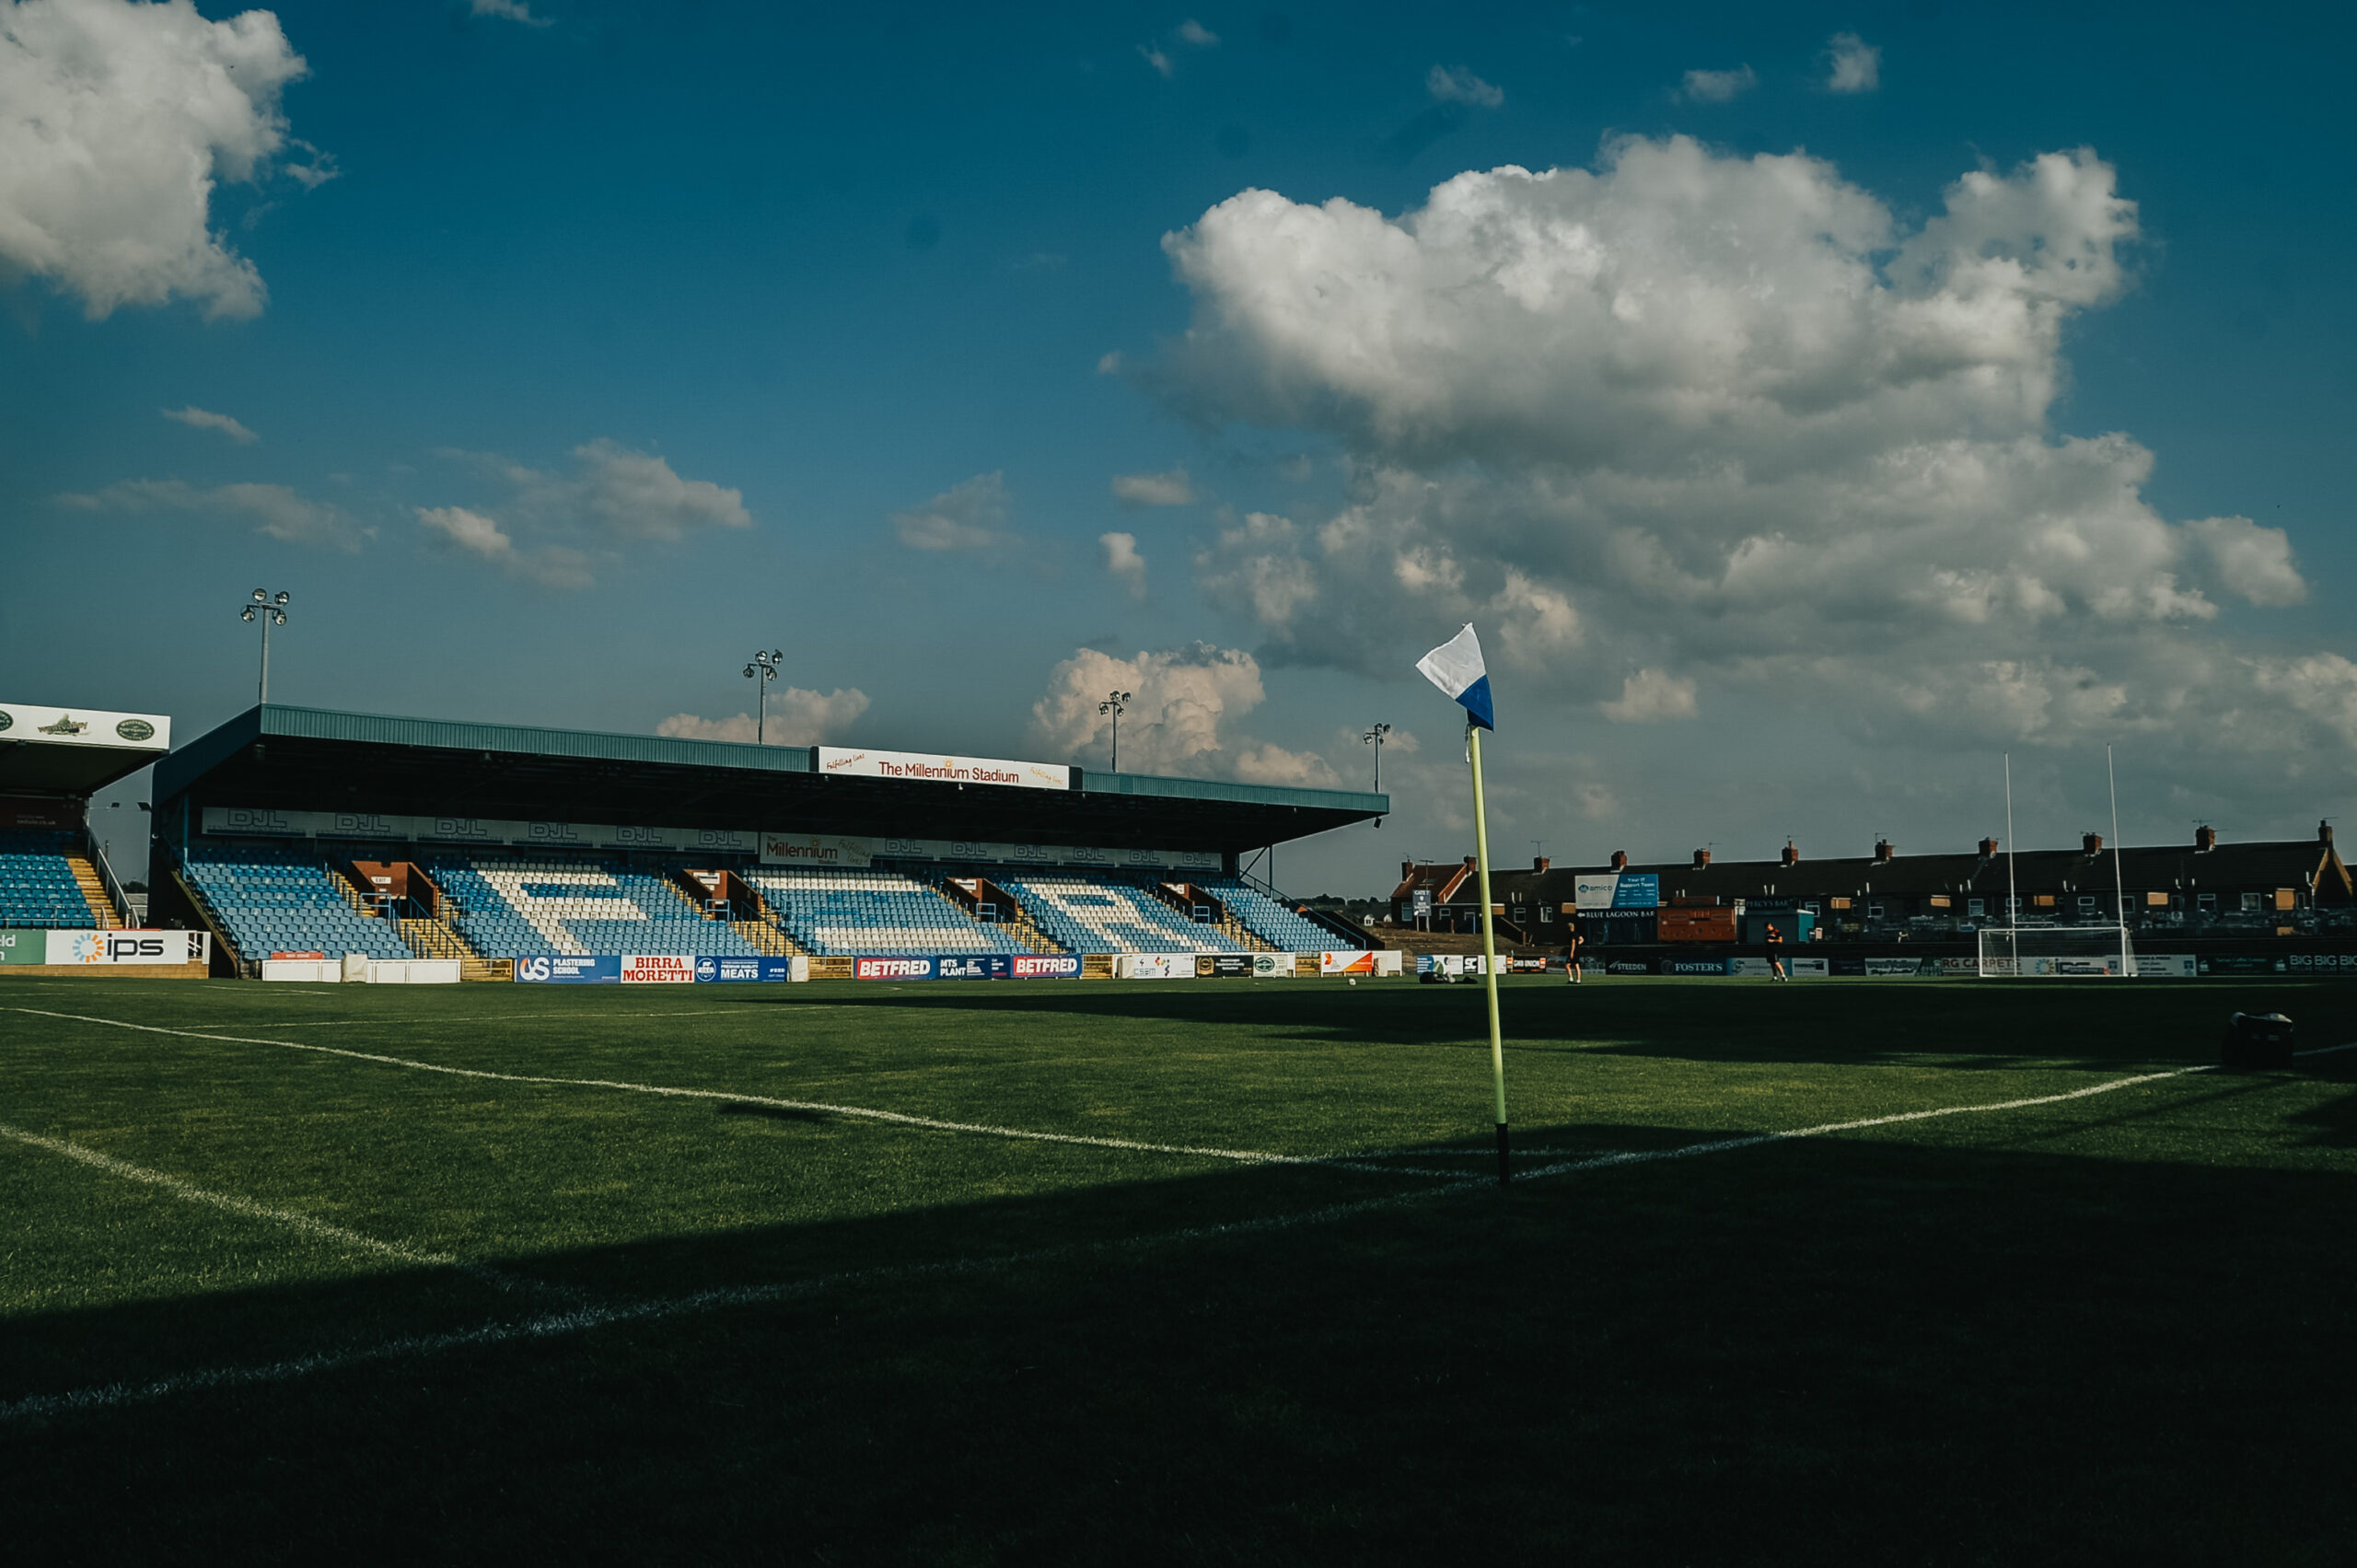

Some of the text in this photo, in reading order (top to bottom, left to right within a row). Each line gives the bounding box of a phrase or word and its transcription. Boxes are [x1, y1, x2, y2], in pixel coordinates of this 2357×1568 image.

[878, 761, 1019, 784] The Millennium Stadium
[228, 809, 287, 829] DJL
[335, 813, 390, 832] DJL
[435, 818, 487, 836] DJL
[528, 822, 577, 840] DJL
[616, 825, 662, 842] DJL
[699, 830, 741, 846] DJL
[766, 841, 838, 860] Millennium
[885, 839, 922, 854] DJL
[951, 842, 986, 856] DJL
[1014, 845, 1048, 859] DJL
[1074, 846, 1105, 861] DJL
[1129, 849, 1161, 863] DJL
[1182, 852, 1212, 865] DJL
[0, 935, 17, 947] ld
[108, 933, 164, 962] ips
[552, 958, 596, 967] PLASTERING
[635, 958, 683, 969] BIRRA
[940, 959, 958, 968] MTS
[1016, 958, 1077, 973] BETFRED
[1675, 962, 1723, 971] FOSTER'S
[1943, 958, 2020, 968] RG CARPETS
[2290, 955, 2313, 966] BIG
[2314, 955, 2338, 966] BIG
[552, 966, 580, 974] SCHOOL
[721, 969, 759, 979] MEATS
[860, 959, 931, 977] BETFRED
[940, 967, 966, 976] PLANT
[622, 970, 692, 981] MORETTI
